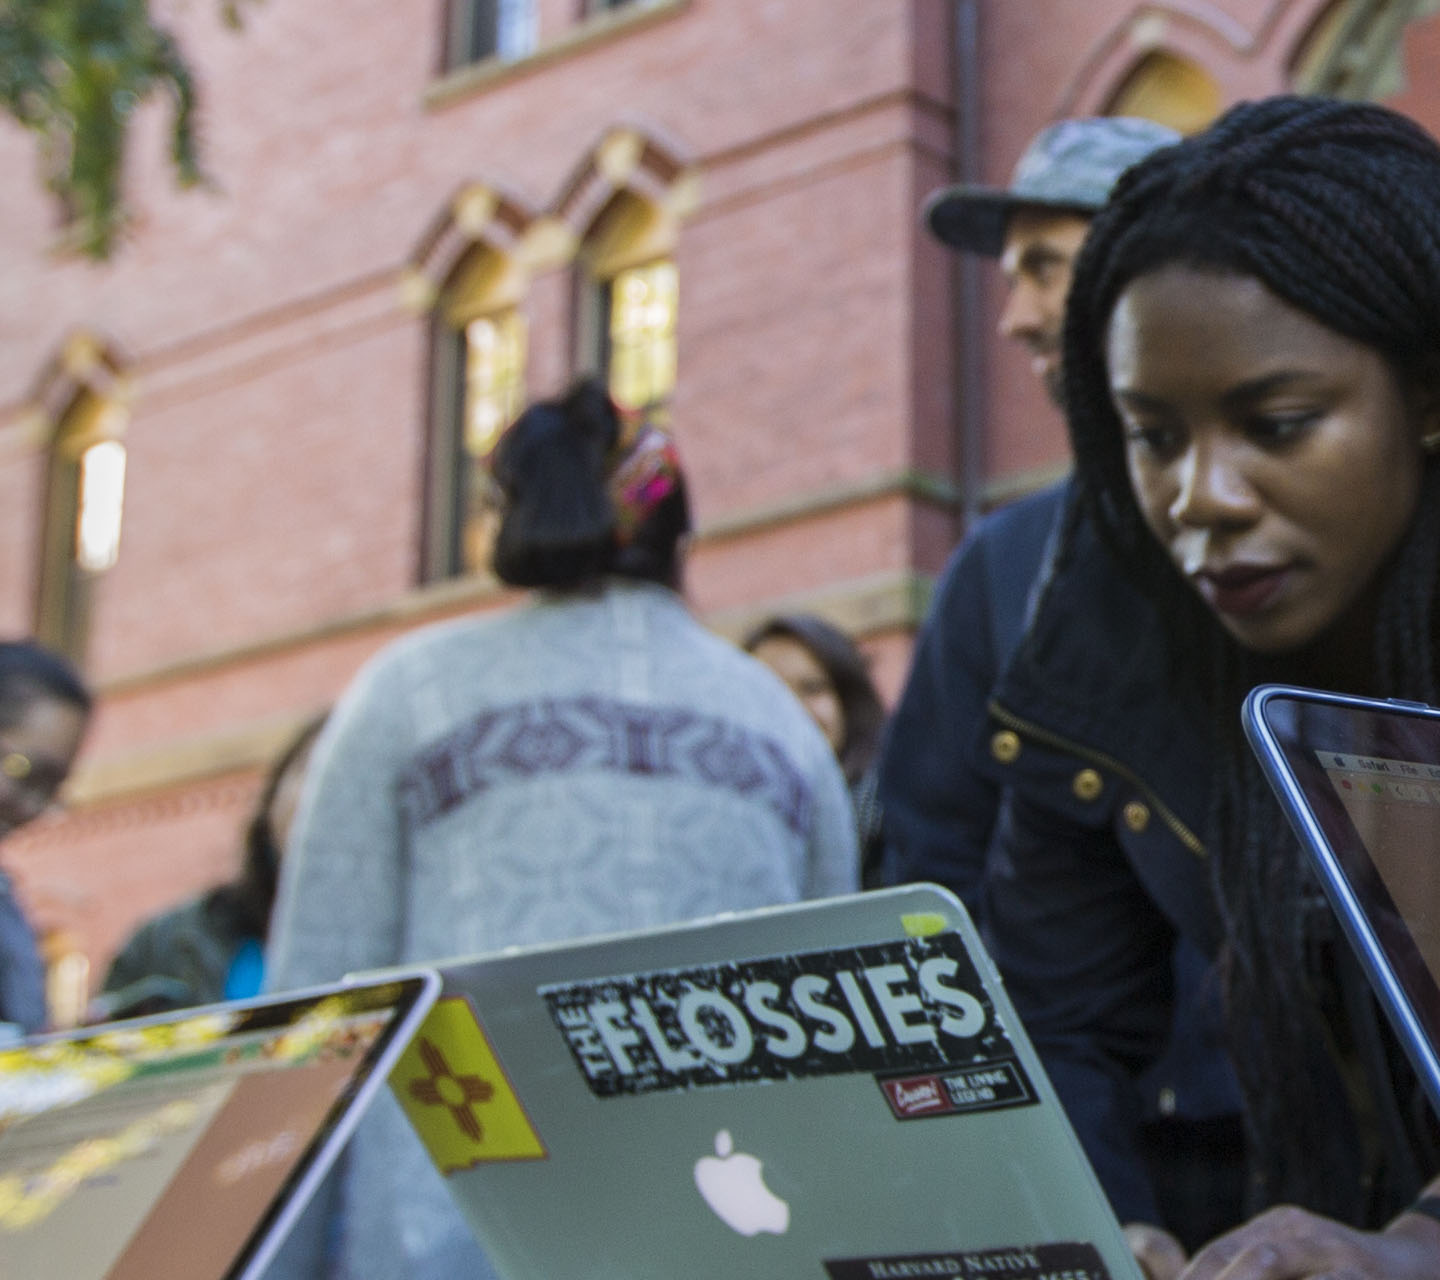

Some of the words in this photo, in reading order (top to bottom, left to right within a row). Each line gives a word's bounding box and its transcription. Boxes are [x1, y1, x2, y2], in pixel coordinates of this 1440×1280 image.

[1358, 759, 1389, 772] Safari
[1399, 765, 1418, 774] File
[560, 1002, 612, 1079] THE
[589, 957, 986, 1075] FLOSSIES
[868, 1258, 962, 1279] HARVARD
[964, 1252, 1040, 1271] NATIVE
